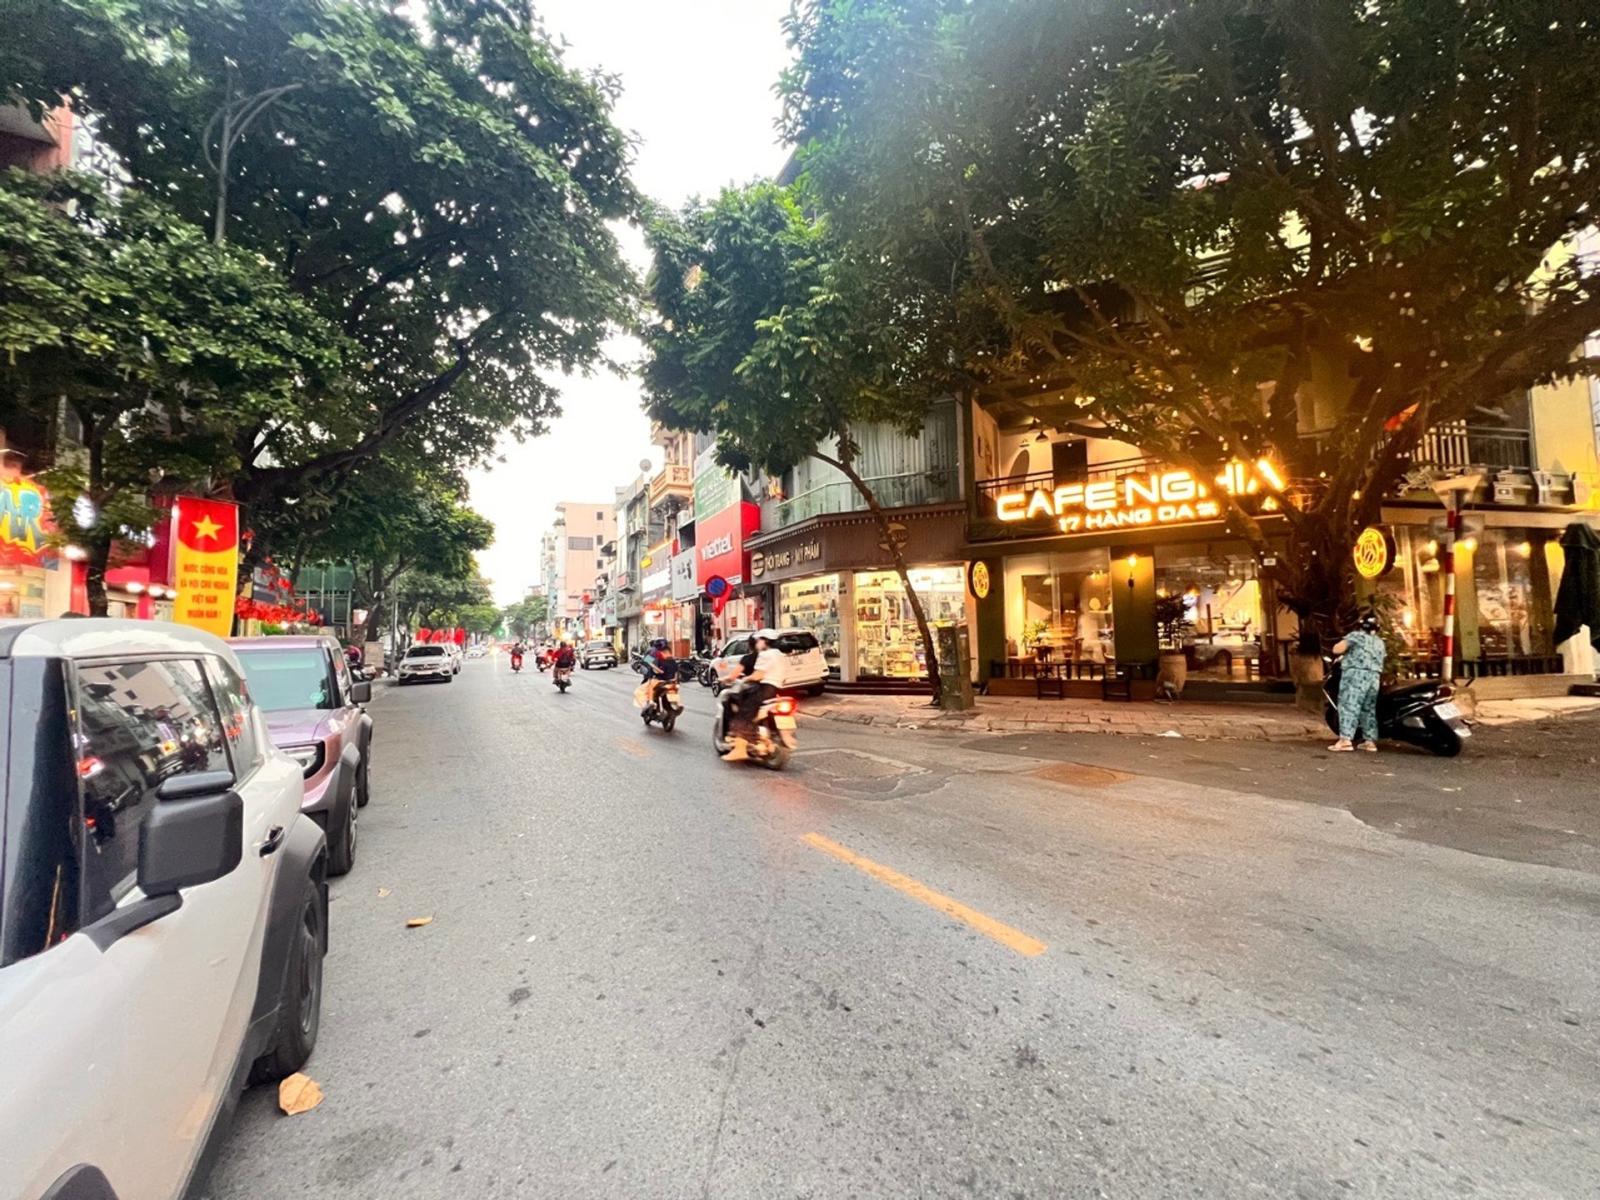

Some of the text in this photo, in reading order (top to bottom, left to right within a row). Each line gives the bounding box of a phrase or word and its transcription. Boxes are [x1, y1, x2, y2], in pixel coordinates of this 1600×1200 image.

[996, 479, 1118, 522] CAFE
[1058, 516, 1080, 533] 17
[1085, 507, 1153, 530] HÀNG
